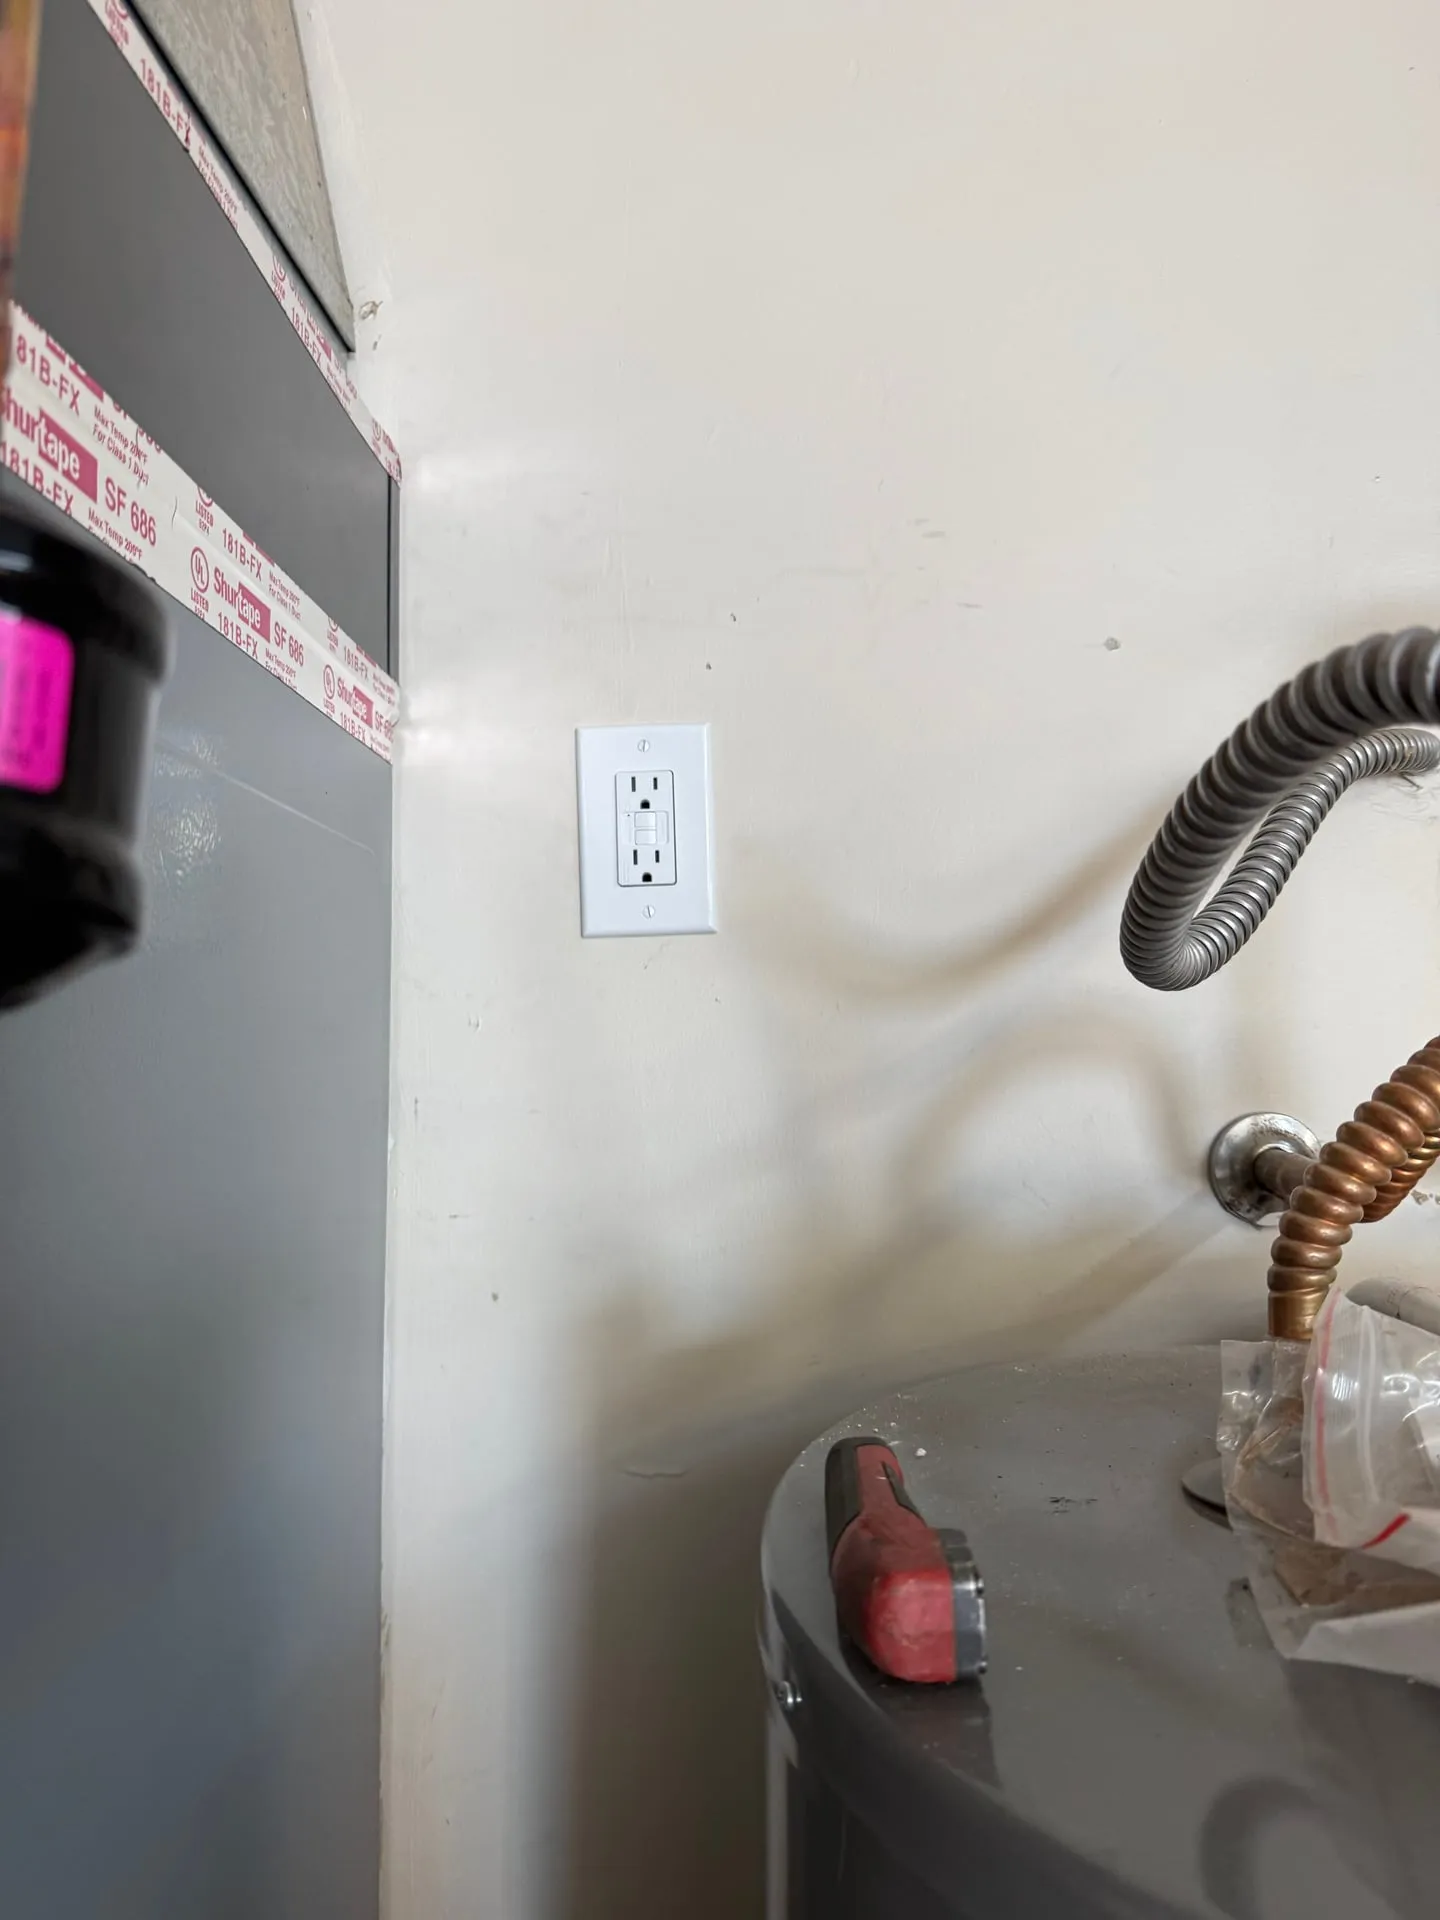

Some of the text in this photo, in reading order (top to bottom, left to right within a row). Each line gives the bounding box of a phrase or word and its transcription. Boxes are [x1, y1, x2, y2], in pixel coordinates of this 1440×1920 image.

[140, 58, 192, 147] 181B-FX
[16, 334, 80, 417] 81B-FX
[4, 385, 80, 481] hurtape
[93, 423, 106, 445] For
[107, 436, 126, 465] Class
[94, 404, 109, 430] Max
[110, 420, 128, 449] Temp
[88, 507, 104, 532] Max
[104, 521, 124, 547] Temp
[105, 476, 127, 517] SF
[131, 500, 157, 548] 686
[195, 500, 214, 527] LISTED
[221, 528, 262, 582] 181B-FX
[190, 588, 209, 613] LISTED
[213, 566, 260, 630] Shurtape
[218, 611, 258, 660] 181B-FX
[273, 621, 304, 668] SF 686
